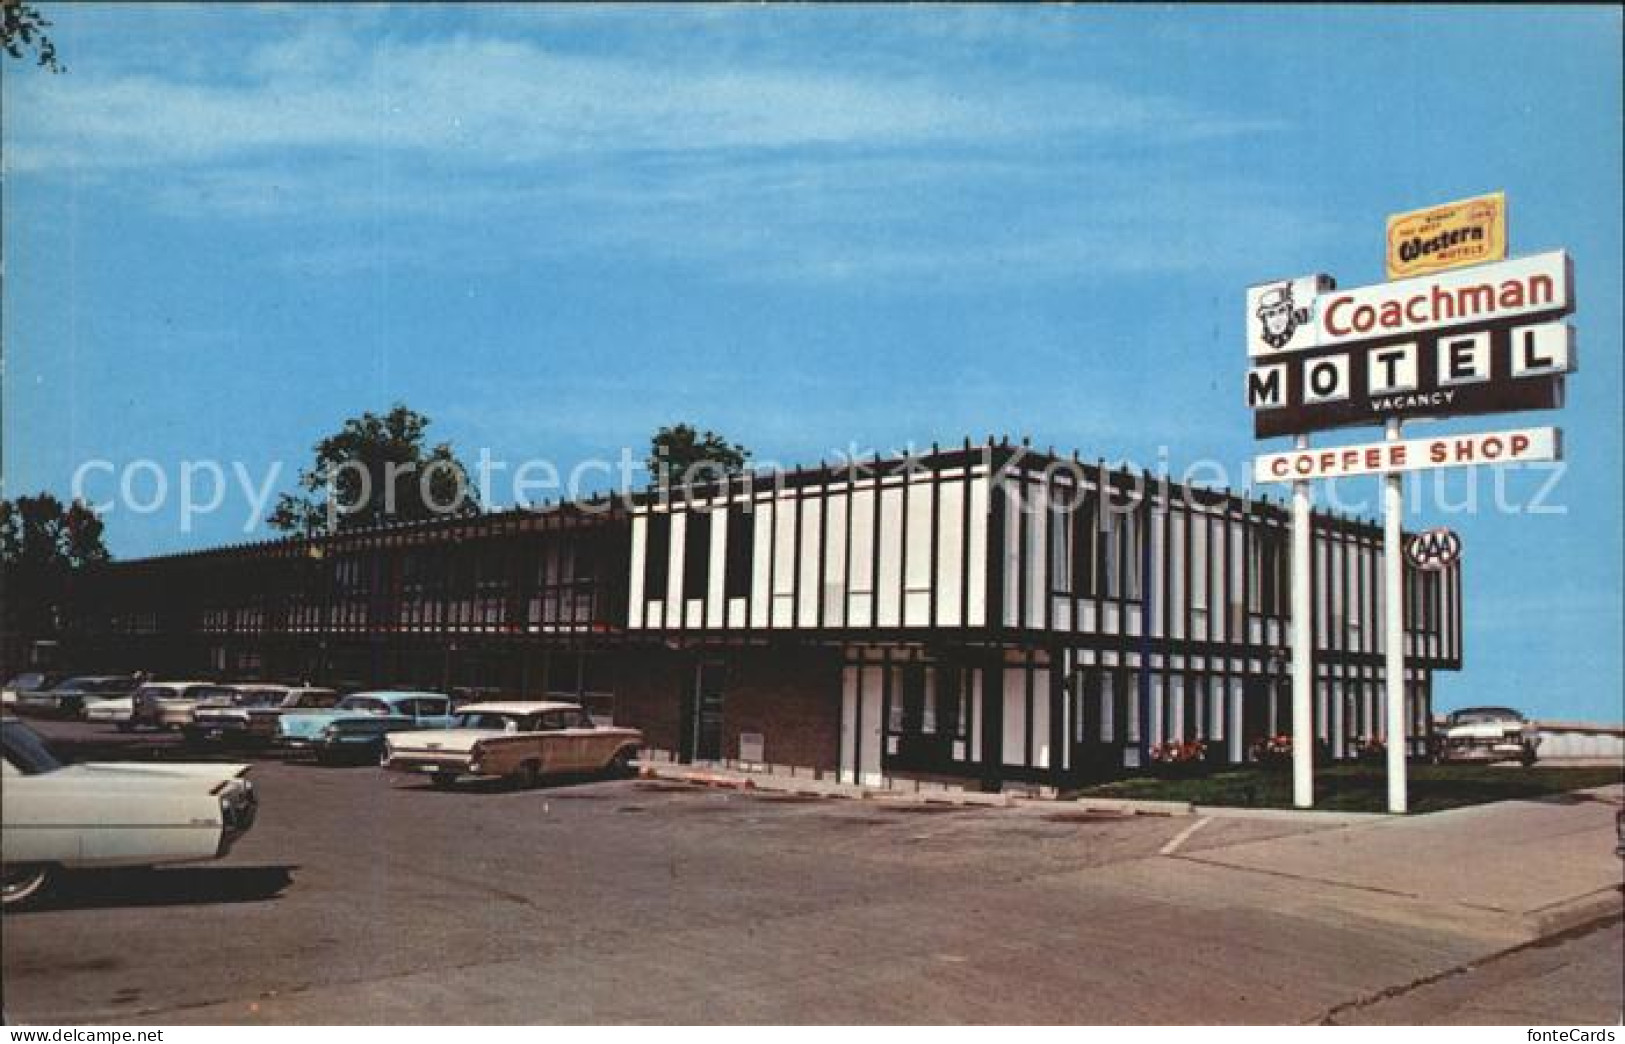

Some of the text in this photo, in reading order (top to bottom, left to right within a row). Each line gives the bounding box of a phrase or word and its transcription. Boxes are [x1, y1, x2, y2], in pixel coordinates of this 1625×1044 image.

[1399, 226, 1483, 263] Western
[1324, 274, 1554, 336] Coachman
[1248, 331, 1553, 406] MOTEL
[1371, 390, 1454, 411] VACANCY
[1271, 435, 1530, 477] COFFEE SHOP
[1412, 533, 1453, 563] AAA
